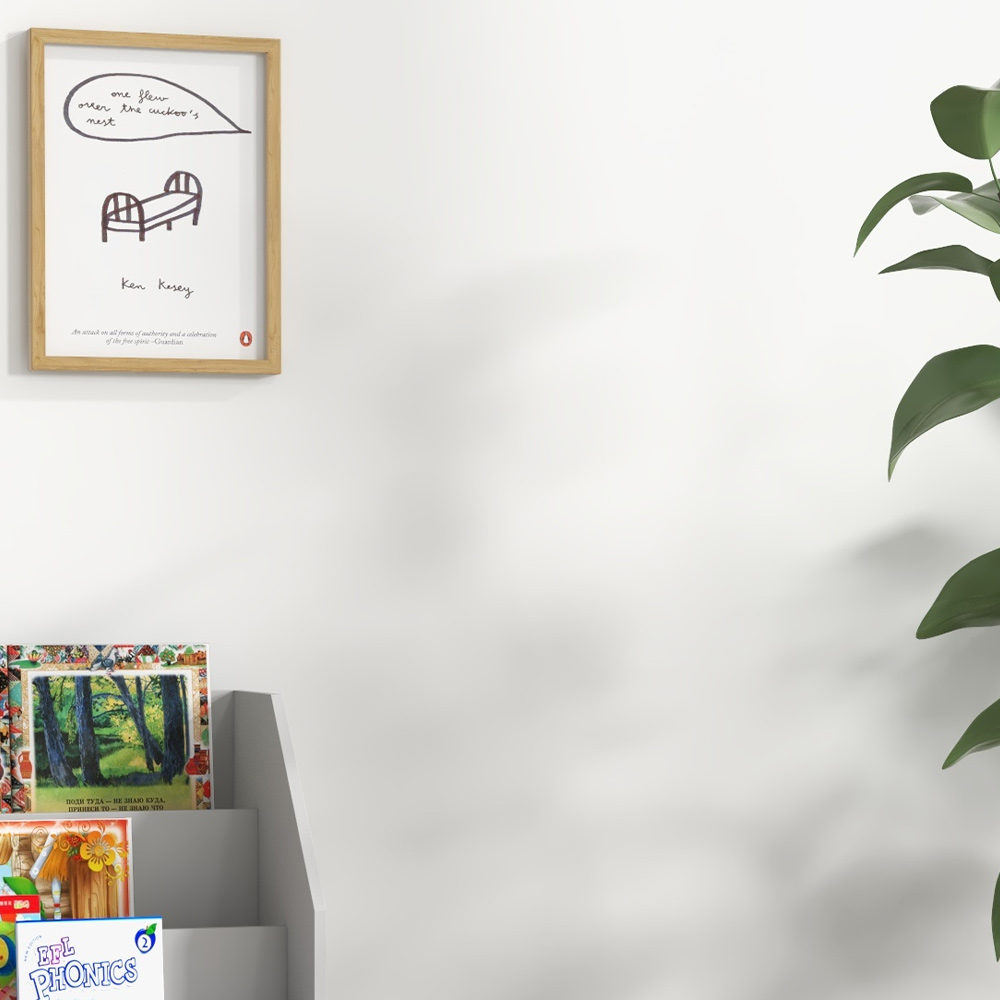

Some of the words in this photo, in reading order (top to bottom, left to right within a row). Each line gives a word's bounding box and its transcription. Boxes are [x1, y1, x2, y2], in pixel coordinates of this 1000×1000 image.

[111, 90, 131, 99] one
[138, 90, 169, 103] flew
[78, 103, 111, 112] over
[120, 104, 142, 113] the
[148, 108, 199, 120] cuckoo's
[87, 116, 116, 127] nest
[121, 277, 146, 291] Ken
[158, 279, 194, 299] Kesey
[142, 937, 148, 948] 2
[37, 936, 75, 967] EFL
